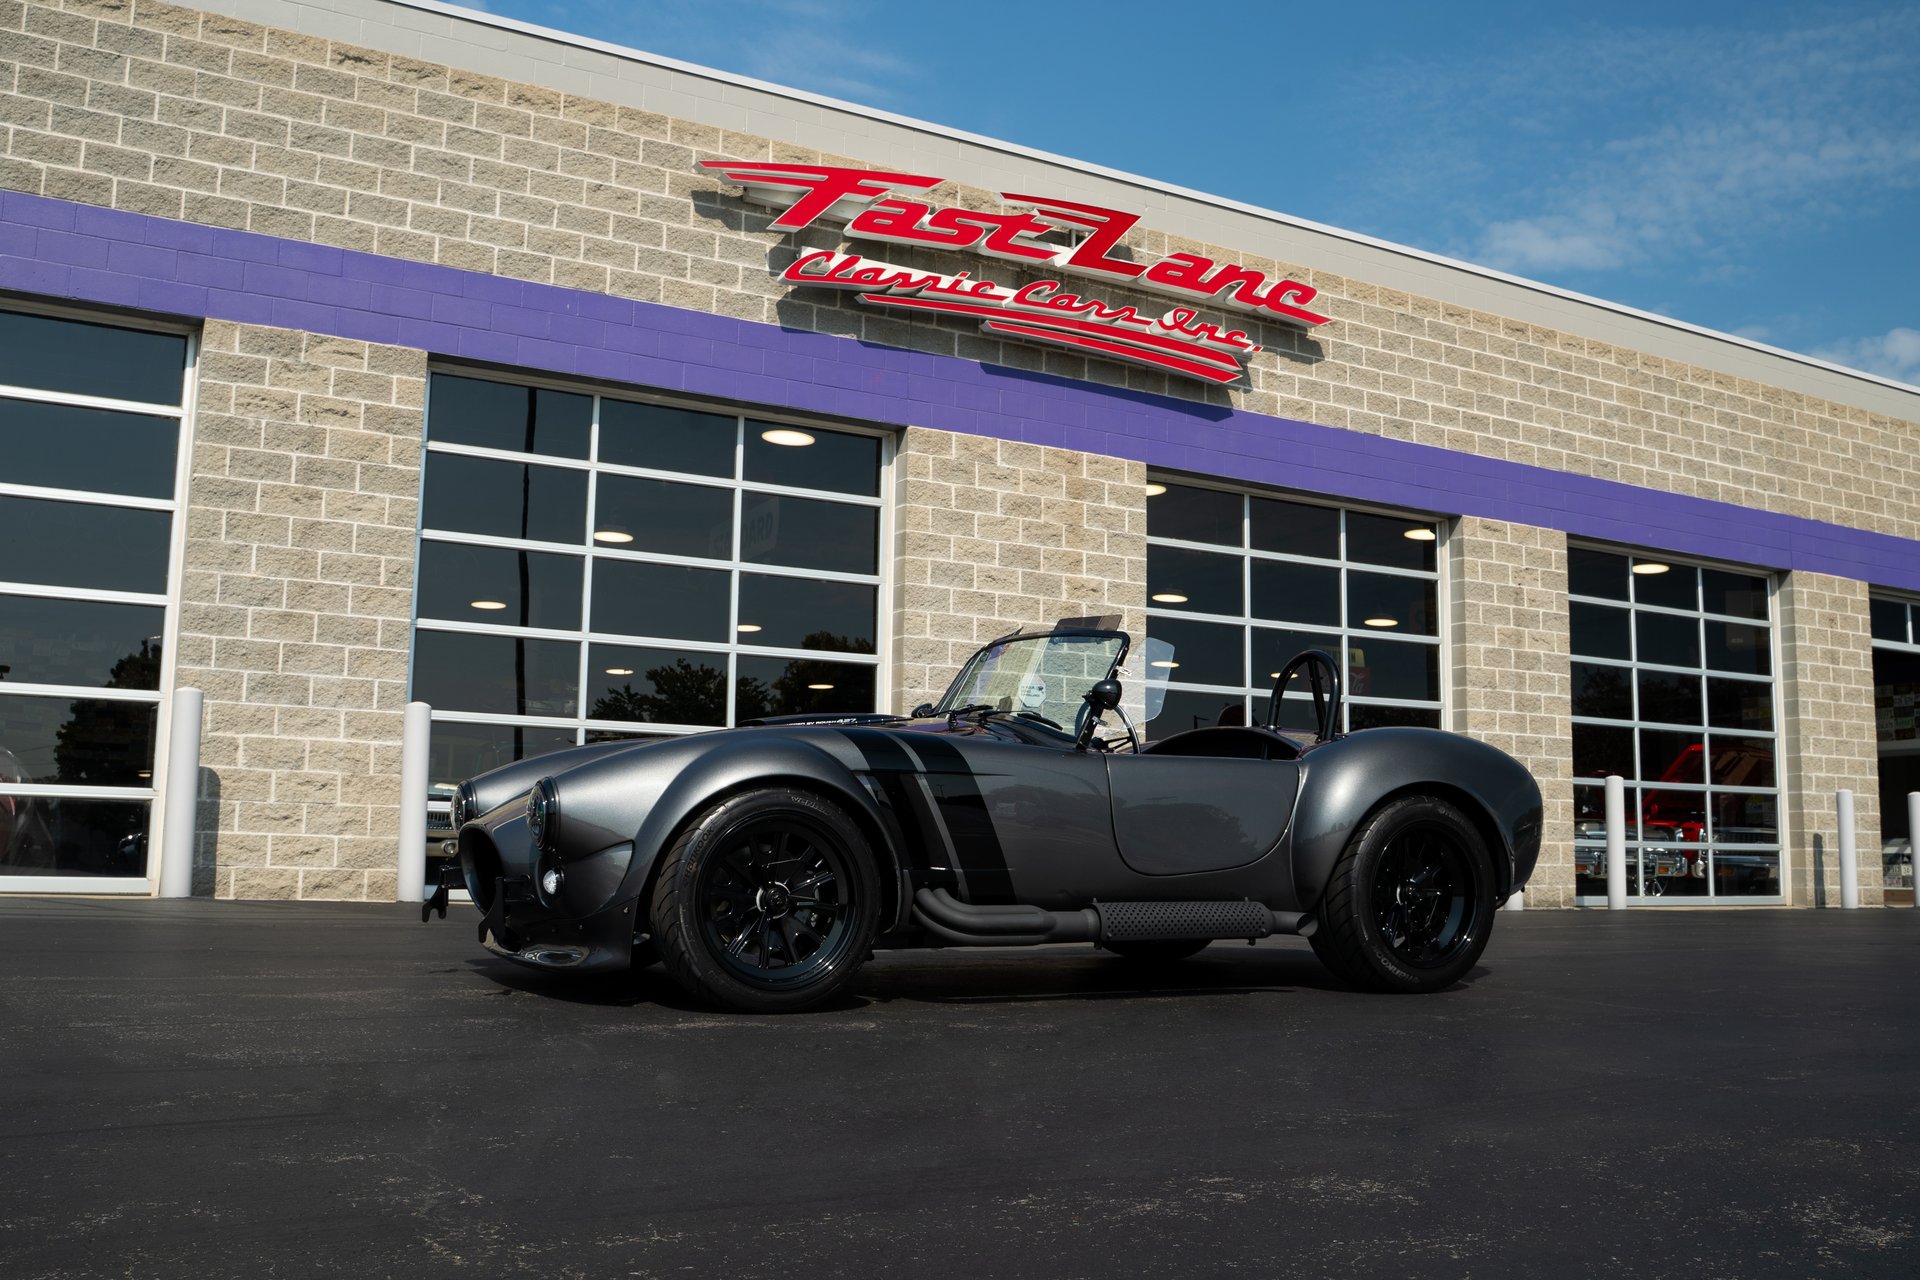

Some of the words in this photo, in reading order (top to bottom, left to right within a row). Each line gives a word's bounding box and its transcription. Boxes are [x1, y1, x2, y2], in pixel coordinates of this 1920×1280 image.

[699, 161, 1062, 262] Fast
[1000, 192, 1333, 325] Lane
[784, 249, 1010, 301] Classic
[1012, 280, 1155, 326] Cars
